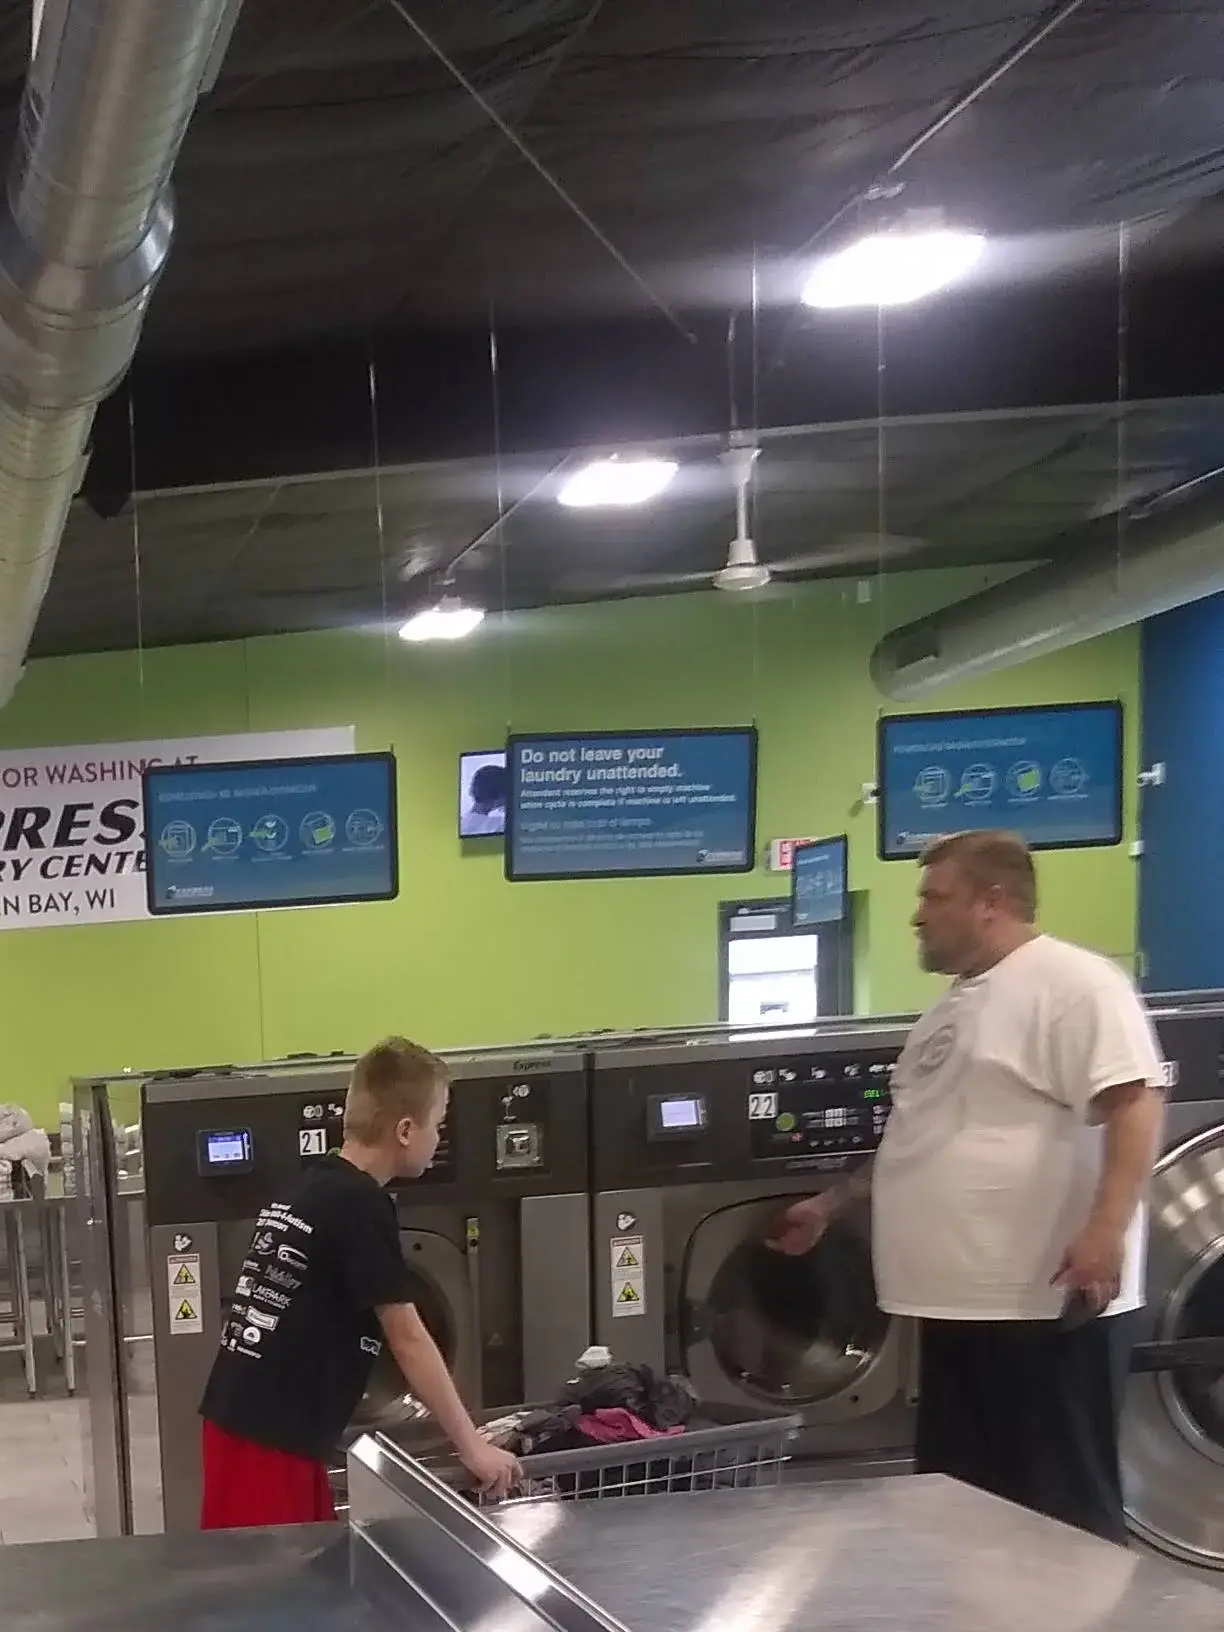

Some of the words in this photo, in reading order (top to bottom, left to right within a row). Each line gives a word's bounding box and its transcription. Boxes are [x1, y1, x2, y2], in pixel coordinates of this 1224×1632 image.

[521, 749, 544, 764] Do
[549, 748, 576, 763] not
[580, 748, 622, 762] leave
[627, 748, 664, 764] your
[520, 767, 582, 785] laundry
[586, 763, 683, 781] unattended.
[39, 850, 148, 880] CENTE
[29, 891, 80, 916] BAY,
[86, 888, 115, 909] WI
[750, 1095, 773, 1118] 22
[302, 1131, 323, 1154] 21
